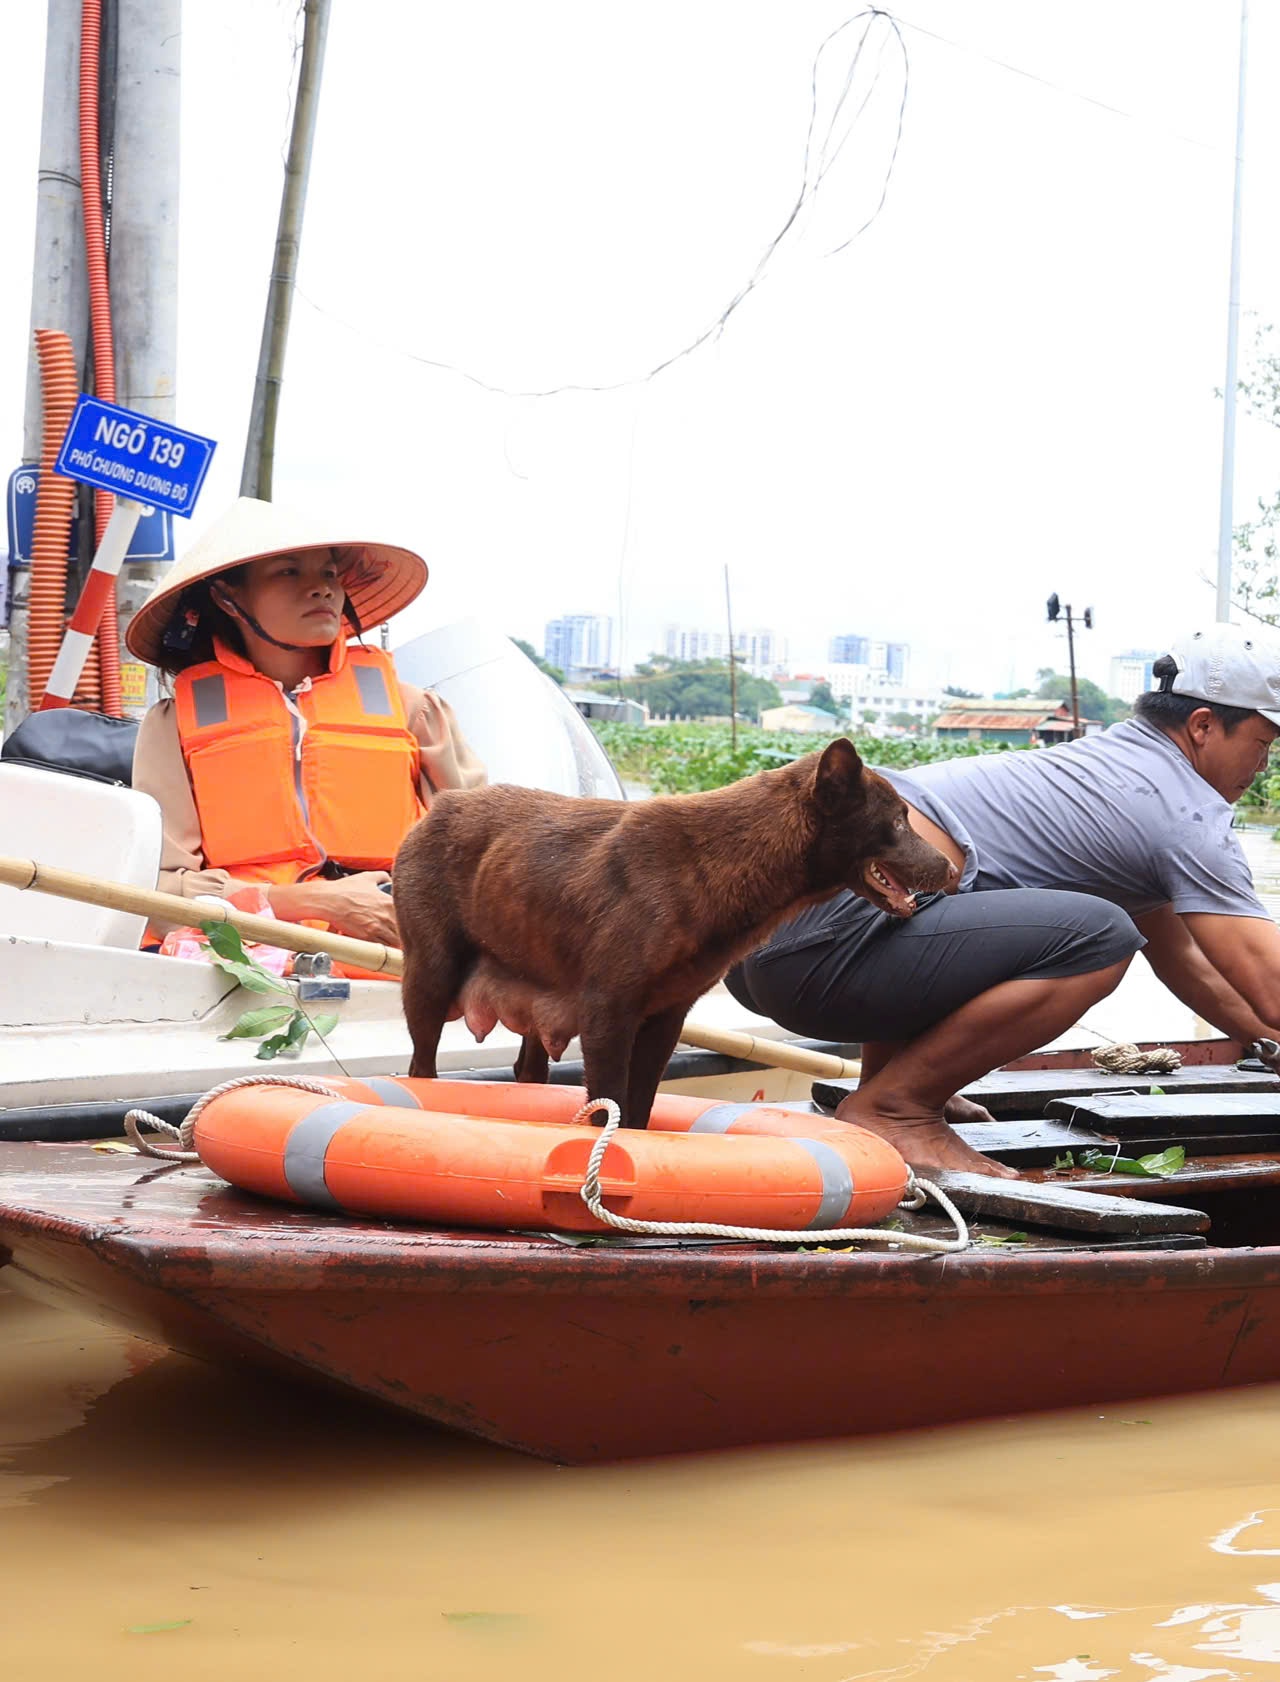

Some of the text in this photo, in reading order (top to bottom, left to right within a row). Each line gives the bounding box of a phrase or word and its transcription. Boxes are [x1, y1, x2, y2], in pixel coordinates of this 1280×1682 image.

[94, 416, 185, 469] NGÕ 139
[69, 448, 97, 467] PHỐ
[171, 483, 189, 504] ĐỘ
